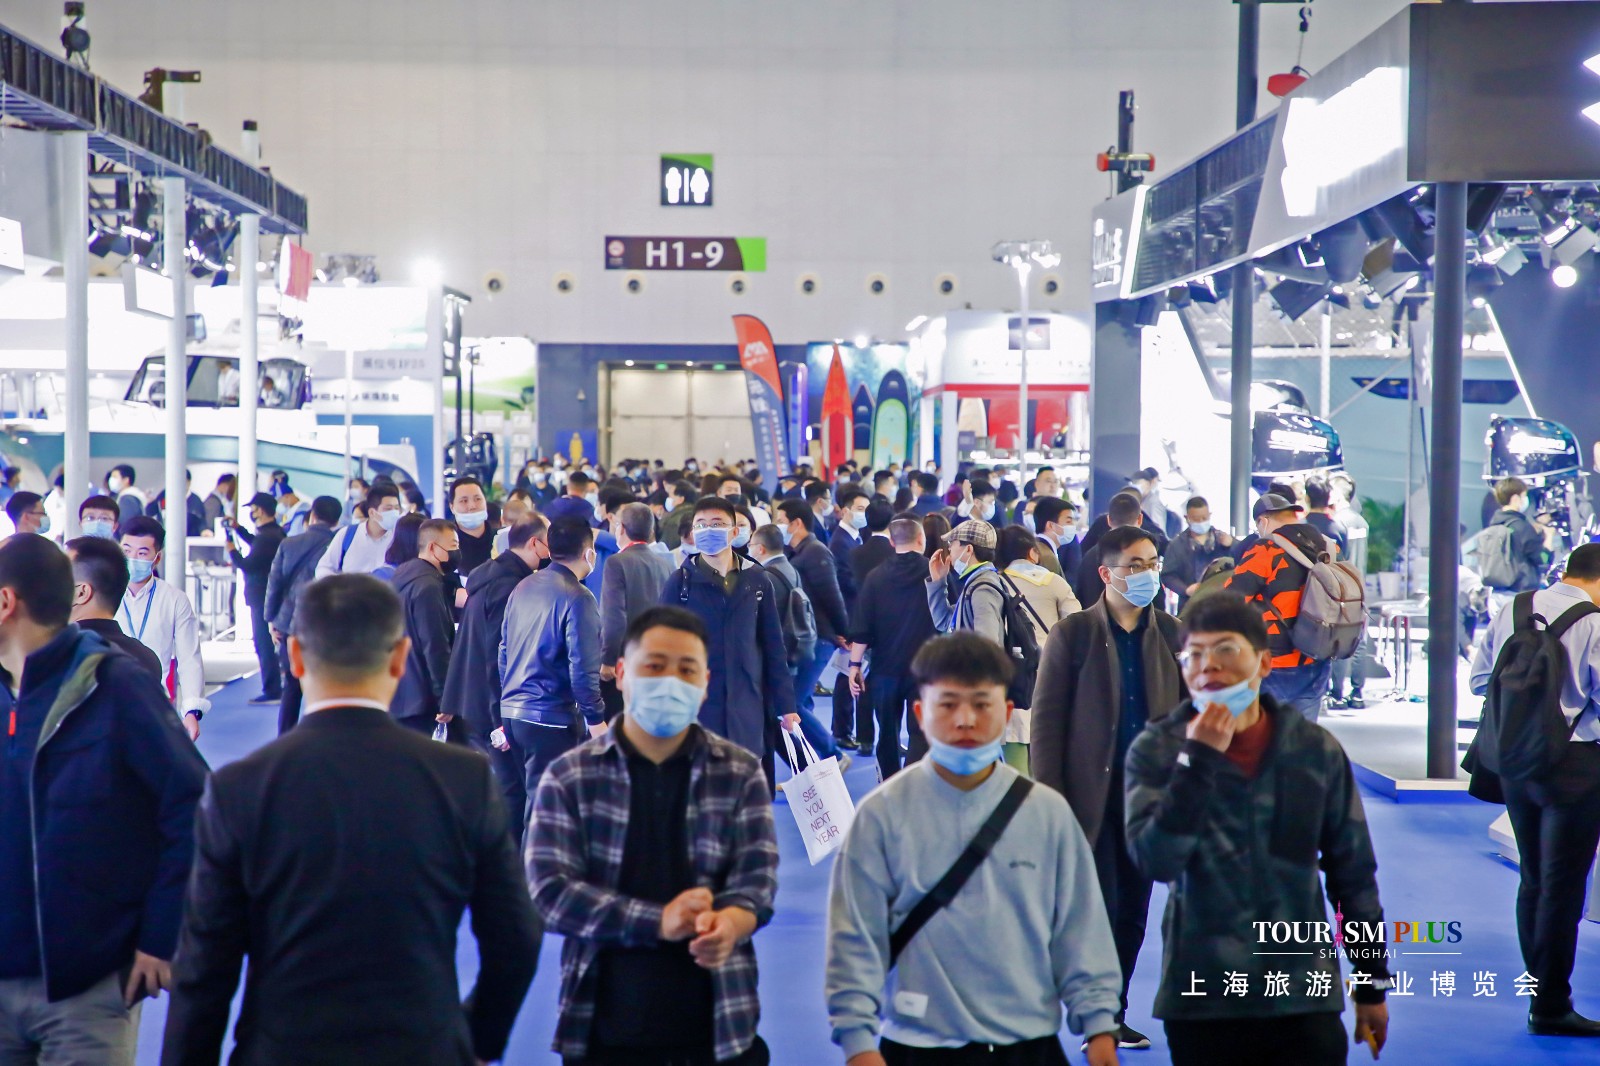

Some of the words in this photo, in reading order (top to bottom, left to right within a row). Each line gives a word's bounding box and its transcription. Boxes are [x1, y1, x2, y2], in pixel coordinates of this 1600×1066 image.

[645, 240, 725, 268] H1-9
[802, 785, 817, 803] SEE
[806, 798, 824, 817] YOU
[810, 811, 831, 832] NEXT
[816, 825, 840, 845] YEAR
